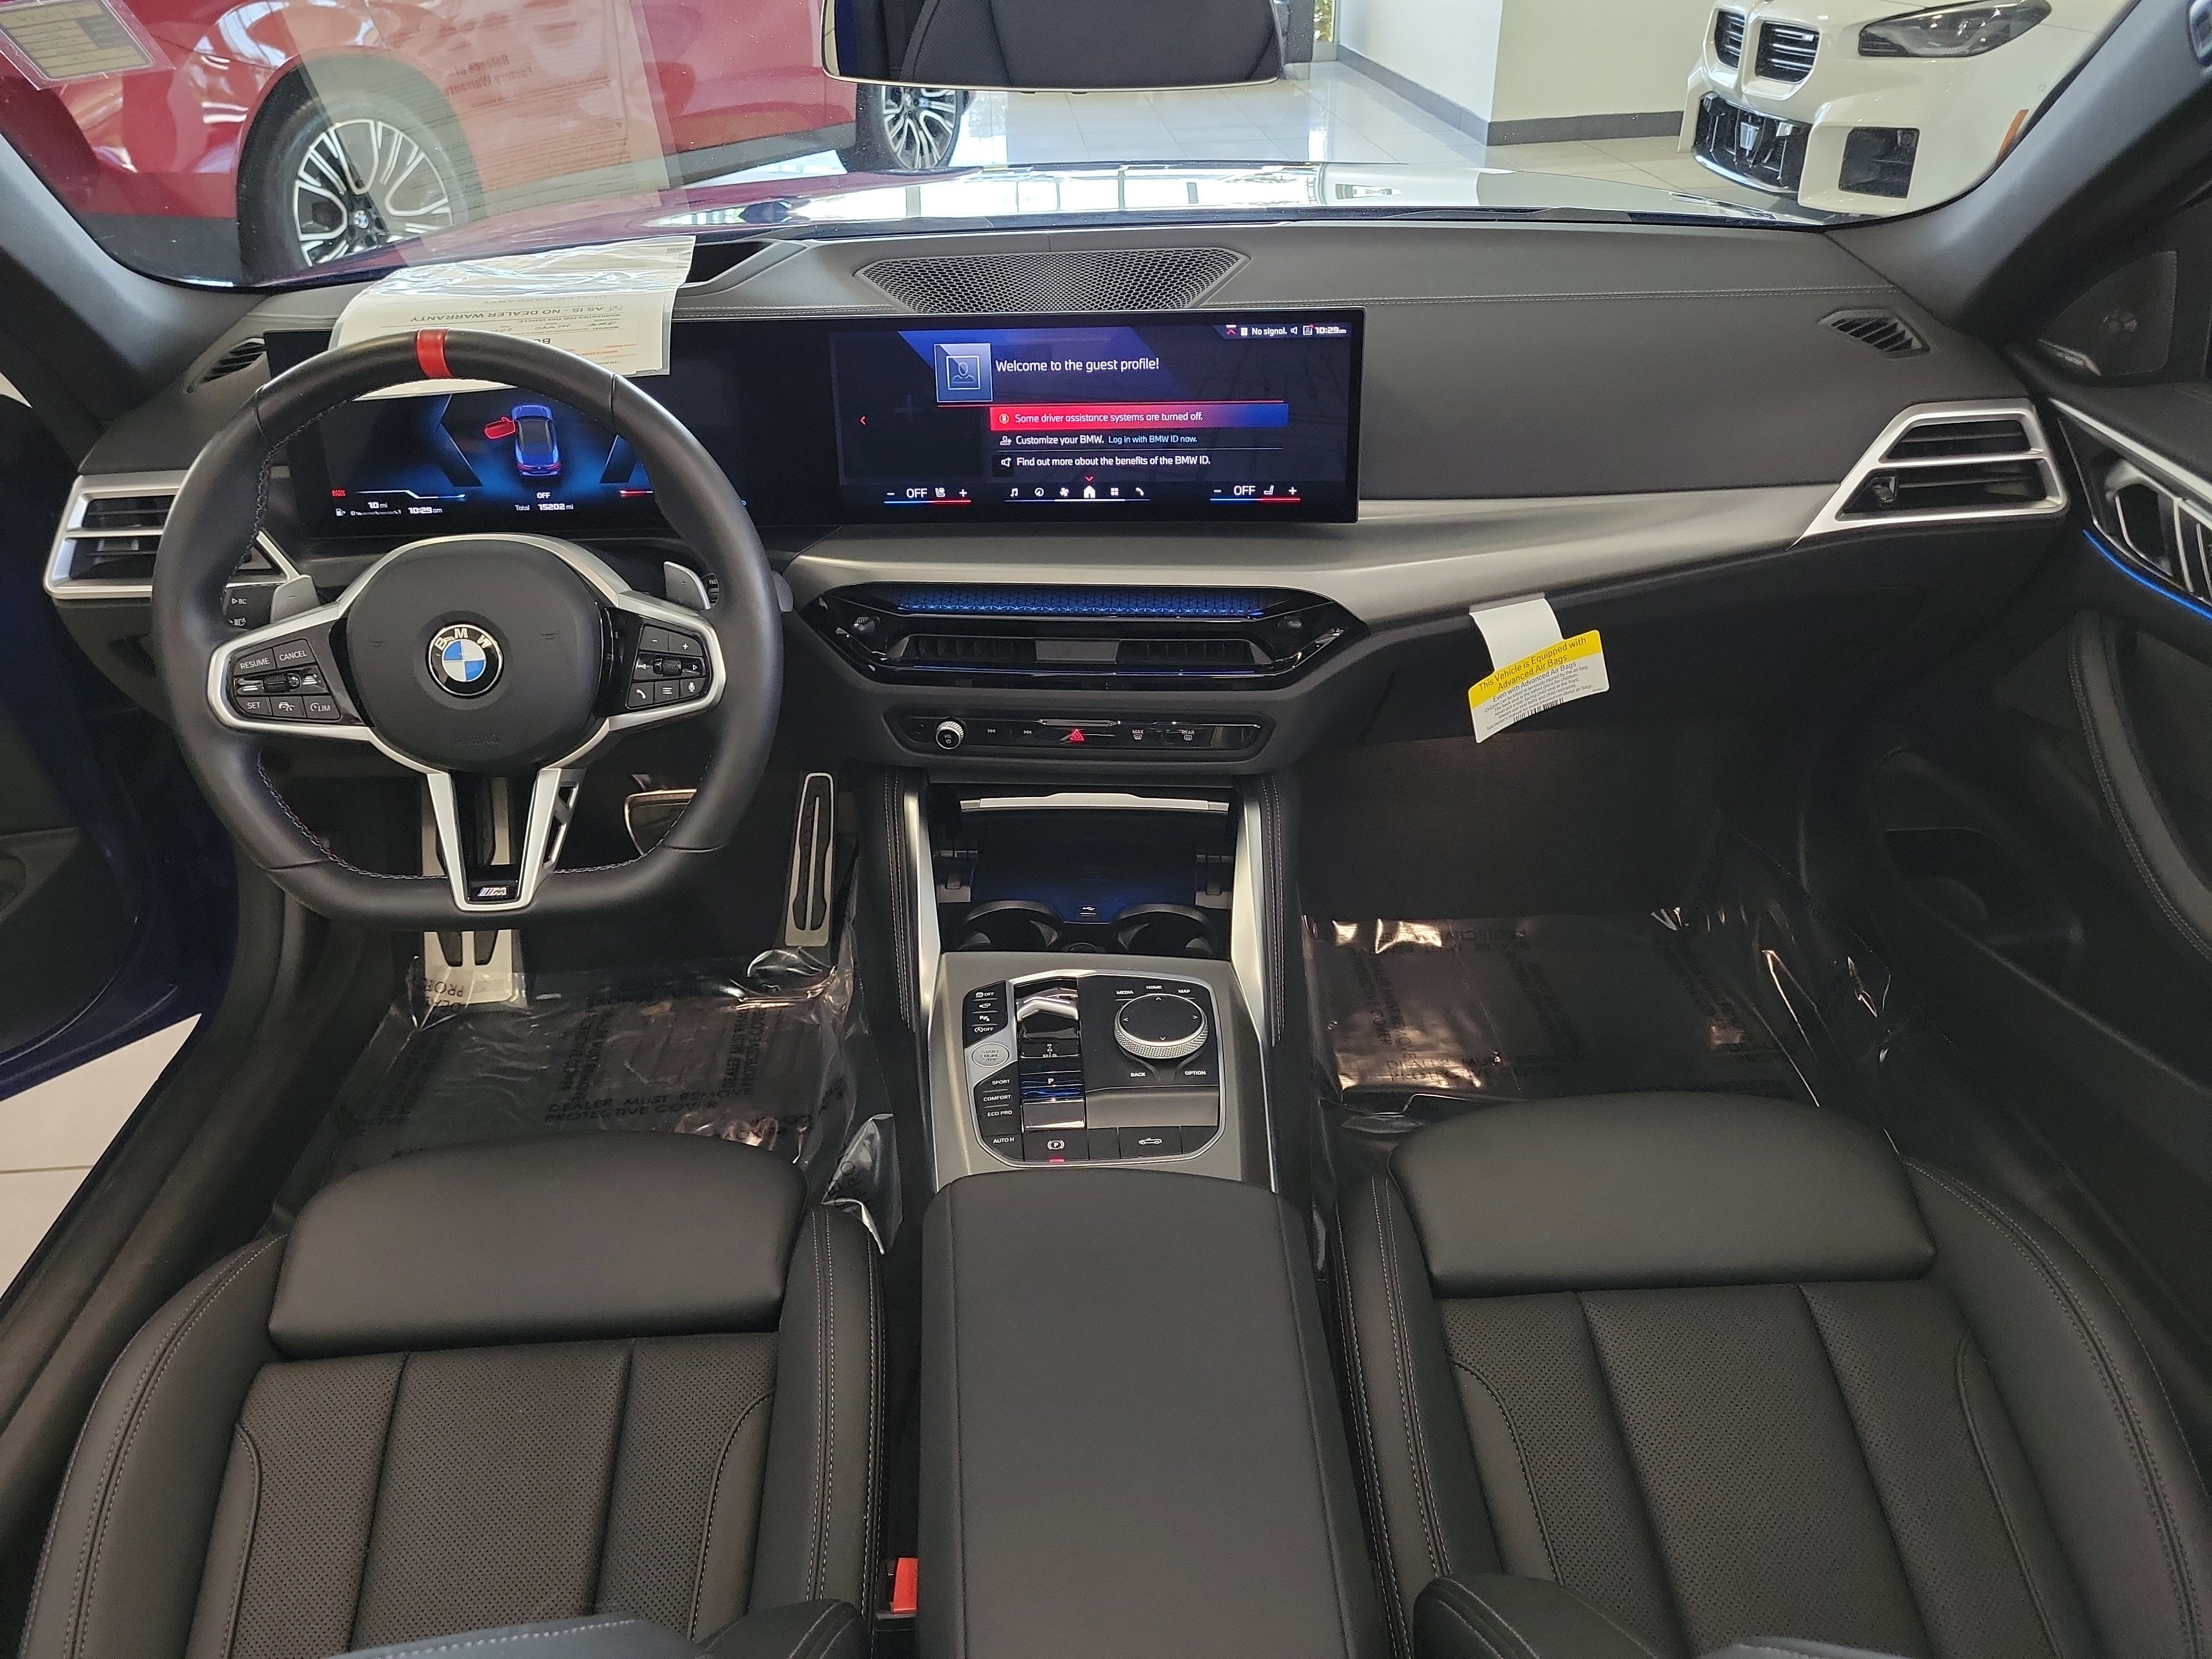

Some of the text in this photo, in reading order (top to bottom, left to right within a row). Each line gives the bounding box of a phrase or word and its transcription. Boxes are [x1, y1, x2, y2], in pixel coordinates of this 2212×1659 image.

[410, 313, 484, 322] WARRANTY
[1263, 328, 1287, 336] signal.
[995, 357, 1160, 373] Welcome to the guest profile!
[1014, 414, 1039, 423] Some
[1041, 413, 1063, 422] driver
[1065, 413, 1108, 422] assistance
[1110, 413, 1144, 423] systems
[1161, 412, 1189, 421] turned
[1190, 411, 1203, 421] off.
[1015, 435, 1104, 446] Customize your BMW.
[1108, 435, 1122, 445] Log
[1124, 435, 1131, 443] in
[1132, 435, 1148, 443] with
[1149, 435, 1169, 443] BMW
[1170, 435, 1179, 443] ID
[1017, 455, 1211, 466] Find out more about the benefits of the BMW ID.
[906, 488, 928, 498] OFF
[1234, 485, 1256, 495] OFF
[434, 628, 493, 651] BMW
[279, 650, 307, 662] CANCEL
[240, 657, 270, 670] RESUME
[1479, 679, 1494, 691] This
[1494, 665, 1522, 682] Vehicle
[1531, 642, 1567, 664] Equipped
[1569, 637, 1587, 648] with
[1498, 655, 1567, 691] Advanced Air Bags
[1493, 692, 1507, 702] Even
[1508, 685, 1520, 695] with
[1521, 671, 1550, 689] Advanced
[1560, 662, 1577, 671] Bags
[247, 702, 261, 710] SET
[624, 1094, 668, 1105] MUST
